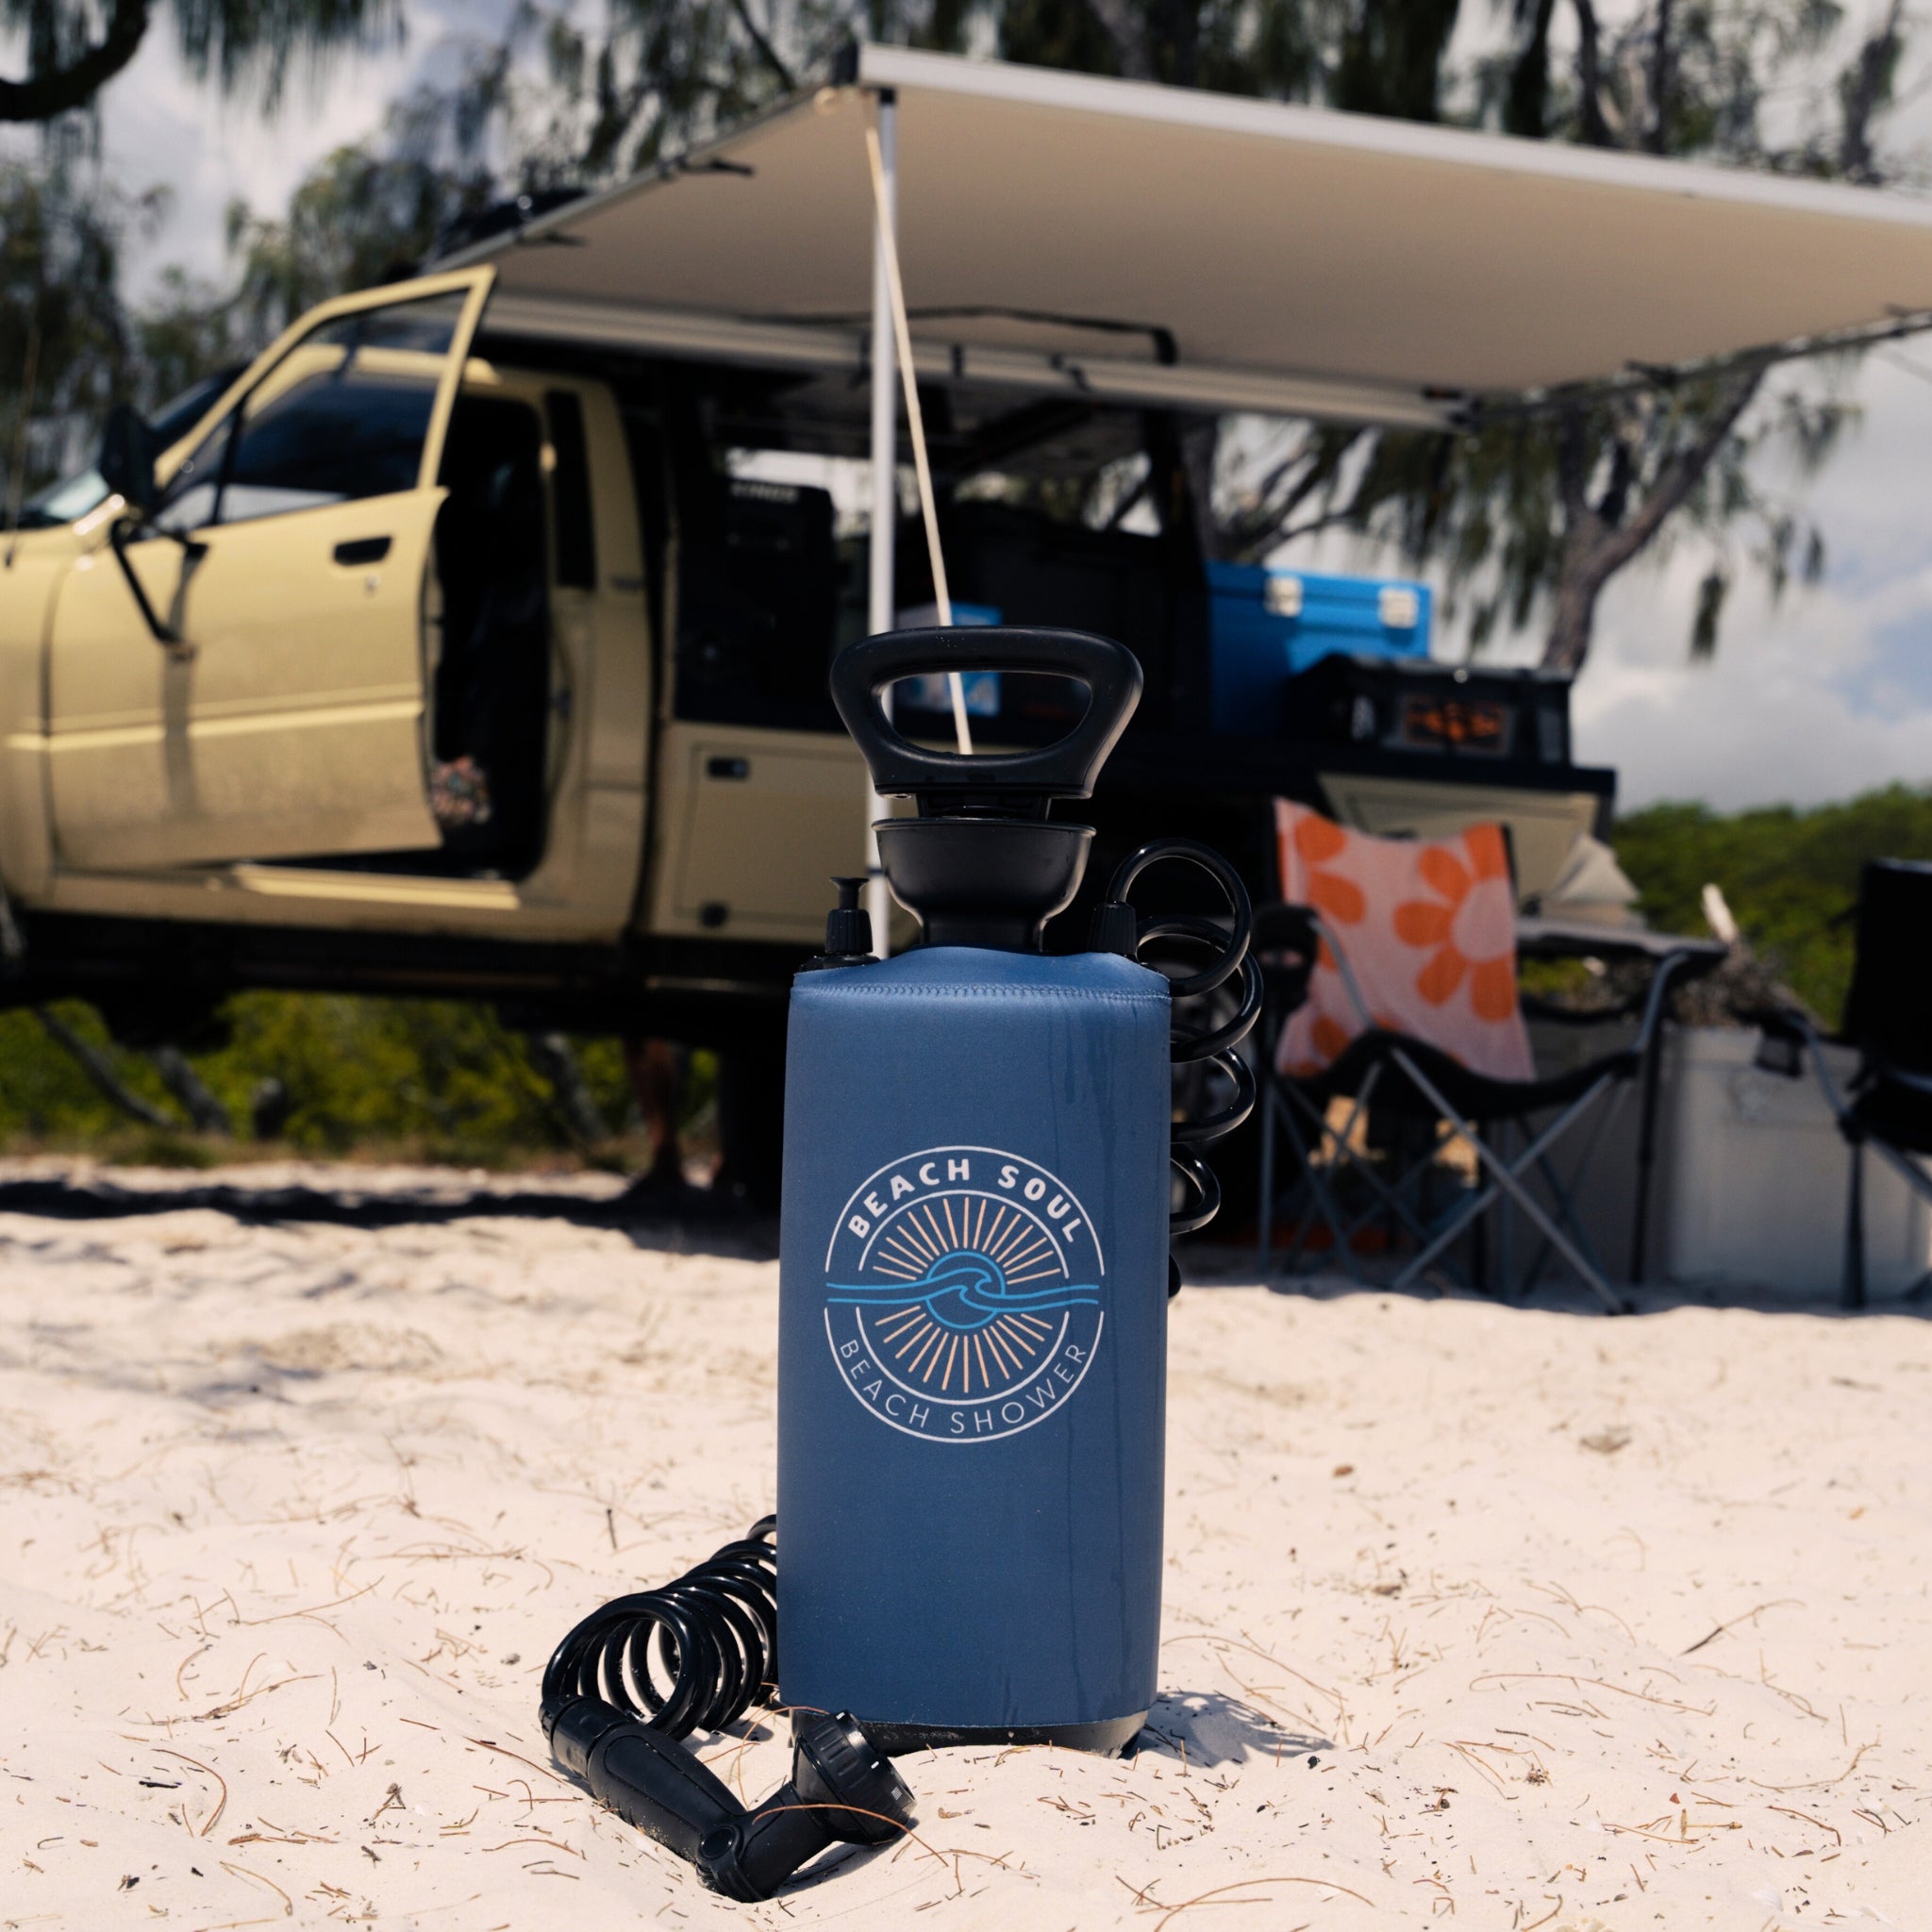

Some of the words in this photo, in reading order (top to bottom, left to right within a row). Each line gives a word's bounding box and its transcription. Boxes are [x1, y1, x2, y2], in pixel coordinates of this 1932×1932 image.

[848, 1158, 970, 1239] BEACH
[997, 1165, 1081, 1242] SOUL
[840, 1340, 930, 1427] BEACH
[950, 1343, 1086, 1434] SHOWER
